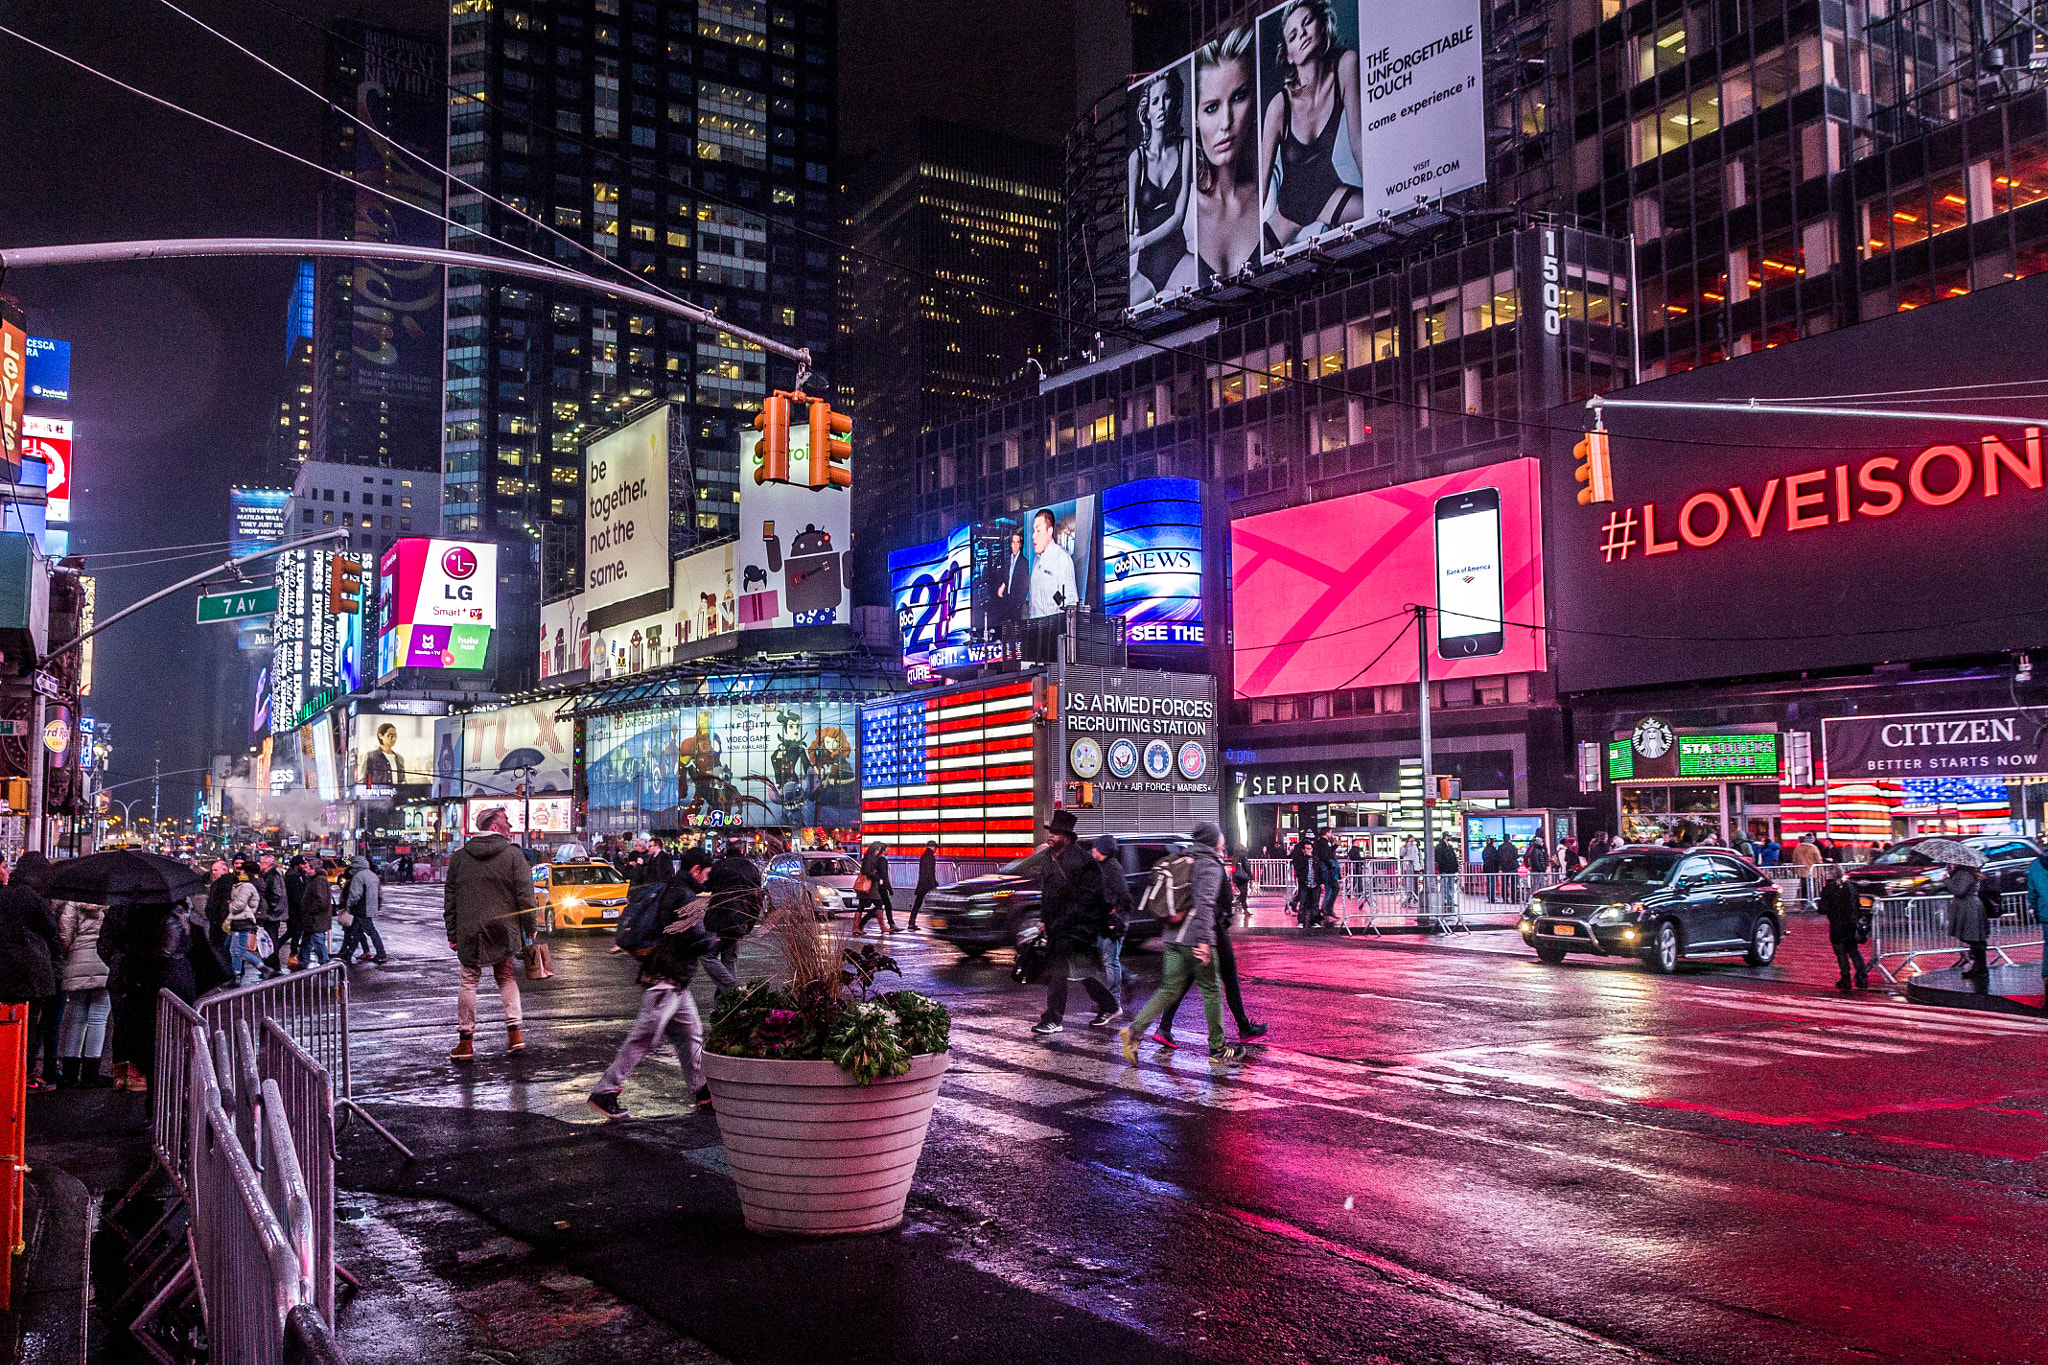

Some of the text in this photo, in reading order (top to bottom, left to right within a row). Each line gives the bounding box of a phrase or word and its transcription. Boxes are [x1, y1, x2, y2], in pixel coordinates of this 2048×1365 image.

[1366, 46, 1390, 69] THE
[1367, 24, 1473, 86] UNFORGETTABLE
[1367, 71, 1412, 103] TOUCH
[1368, 75, 1476, 131] come experience it
[1412, 159, 1431, 172] VISIT
[1385, 159, 1460, 196] WOLFORD.COM
[1543, 230, 1560, 335] 1500
[752, 443, 810, 465] aroi
[591, 460, 607, 484] be
[590, 477, 647, 521] together.
[1600, 426, 2044, 563] #LOVEISON
[590, 520, 635, 554] not the
[1130, 551, 1191, 571] NEWS
[590, 559, 628, 589] same.
[444, 584, 473, 601] LG
[223, 598, 232, 615] 7
[432, 605, 461, 617] Smart
[457, 636, 479, 645] hulu
[1131, 625, 1204, 641] SEE THE
[1091, 694, 1150, 714] ARMED
[1153, 698, 1213, 718] FORCES
[1068, 715, 1206, 736] RECRUITING STATION
[725, 735, 771, 743] VIDEO GAME
[1682, 741, 1773, 755] STARBUCKS
[1699, 755, 1756, 767] COFFEE
[1867, 754, 2039, 770] BETTER STARTS NOW
[1131, 783, 1143, 791] AIR
[1146, 783, 1171, 791] FORCE
[1177, 783, 1208, 792] MARINES
[1252, 772, 1363, 795] SEPHORA
